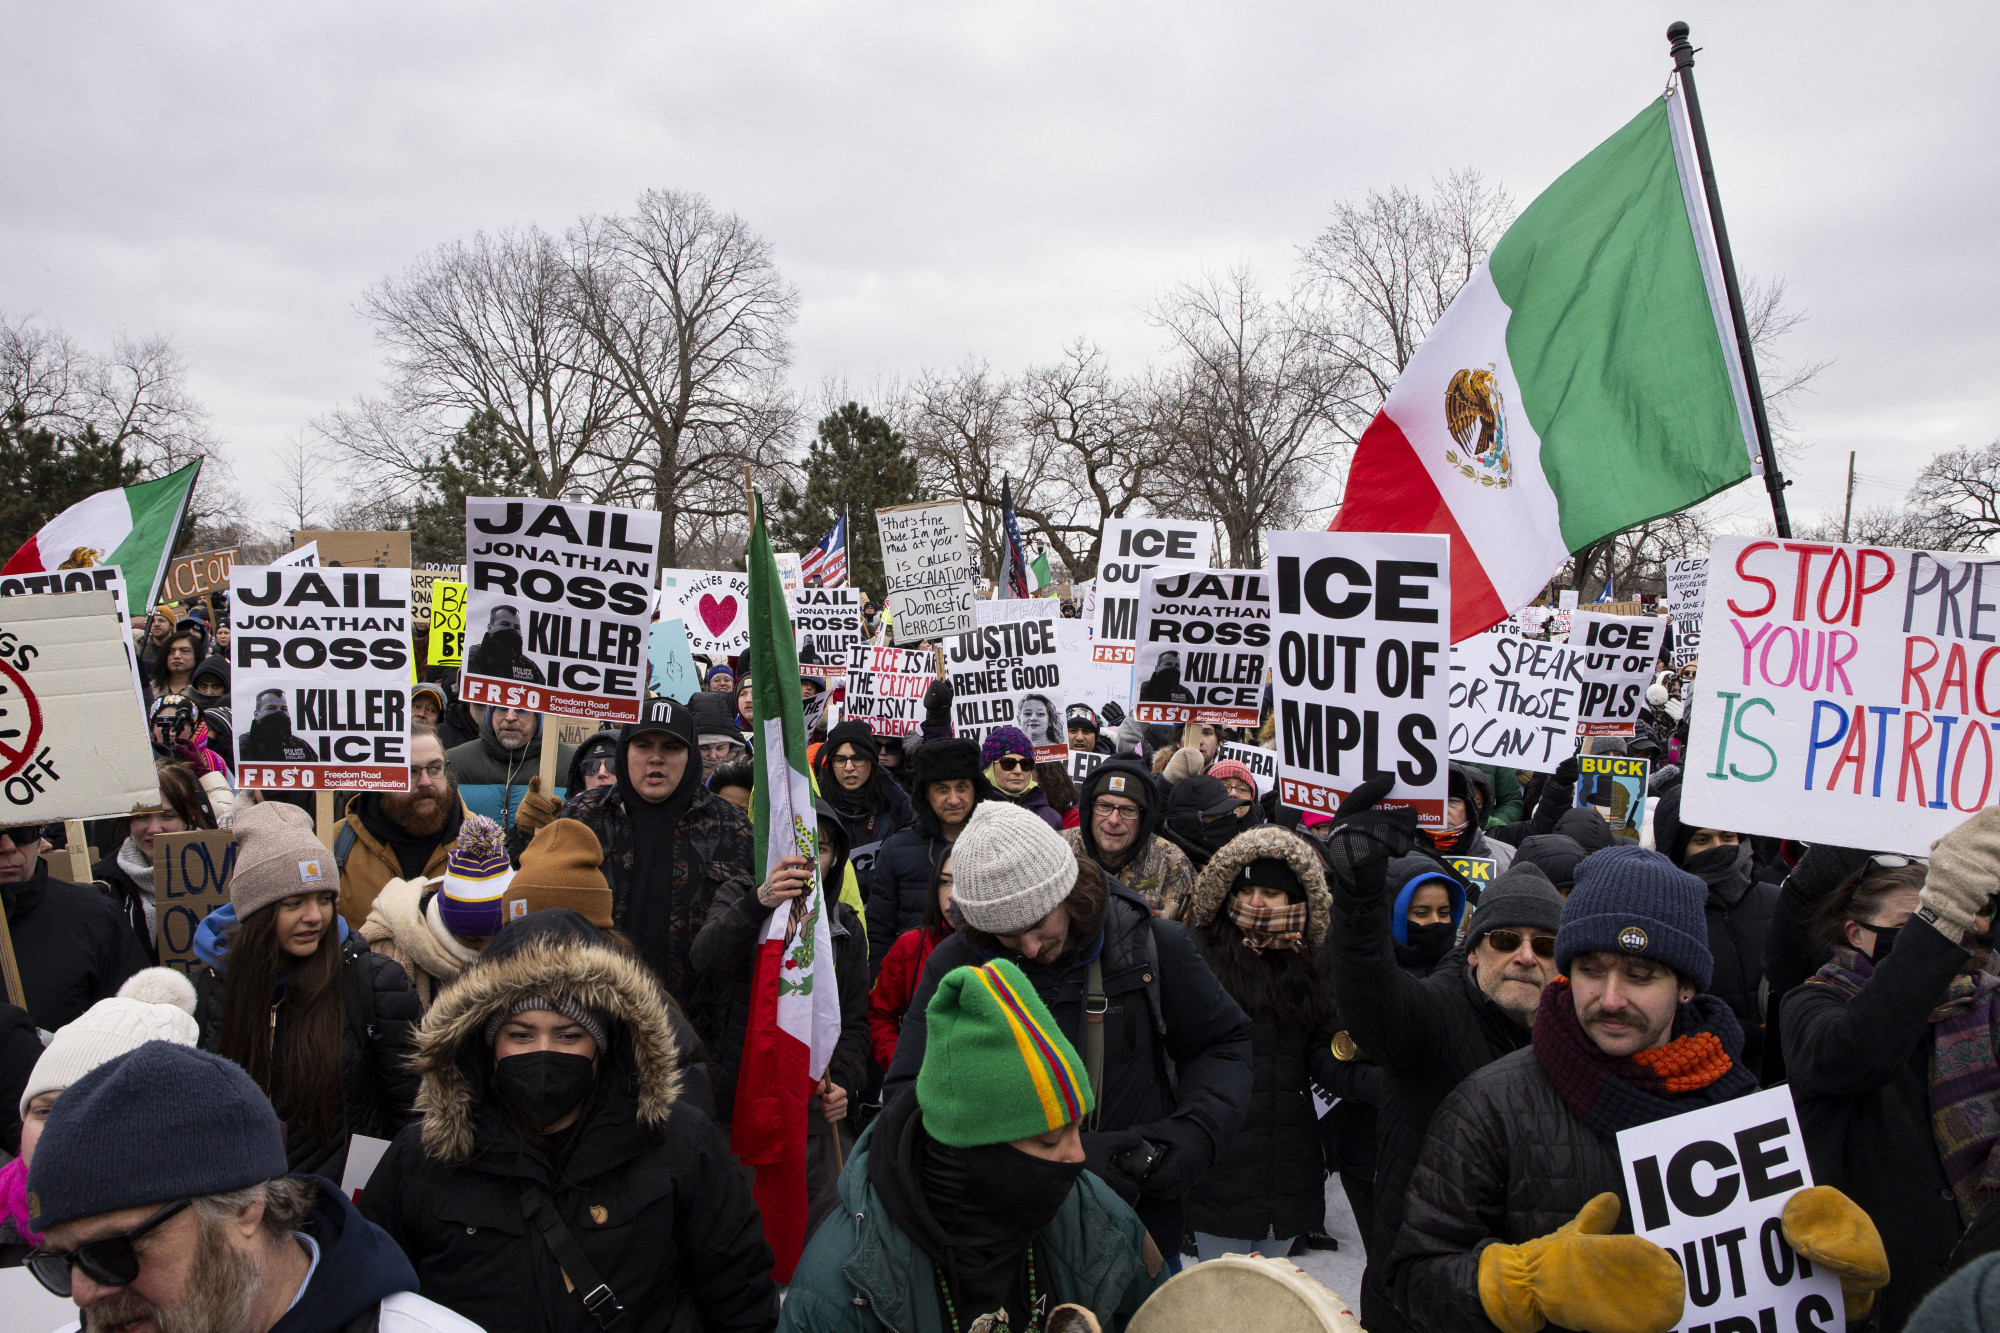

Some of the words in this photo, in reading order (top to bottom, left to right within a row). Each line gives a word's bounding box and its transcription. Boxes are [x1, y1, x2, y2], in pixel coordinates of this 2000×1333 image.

[473, 502, 653, 554] JAIL
[919, 511, 944, 527] fine
[934, 526, 950, 536] not
[1118, 528, 1197, 560] ICE
[426, 562, 440, 572] DO
[442, 564, 460, 573] NOT
[472, 542, 649, 578] JONATHAN
[918, 551, 962, 568] CALLED
[1675, 558, 1709, 573] ICE!
[164, 558, 210, 600] ICE
[1102, 562, 1160, 584] OU
[1674, 579, 1707, 591] ABSOLVE
[236, 571, 406, 609] JAIL
[442, 586, 467, 612] BA
[473, 560, 648, 616] ROSS
[730, 577, 749, 599] BEL
[796, 590, 858, 605] JAIL
[1155, 574, 1270, 602] JAIL
[1277, 556, 1439, 624] ICE
[1727, 541, 1895, 627] STOP
[1903, 551, 2000, 642] PRE
[992, 599, 1059, 623] BREAKS
[1151, 604, 1270, 619] JONATHAN
[1670, 602, 1680, 612] NO
[1683, 601, 1699, 609] ONE
[236, 615, 405, 632] JONATHAN
[434, 610, 466, 631] DO
[797, 617, 859, 630] ROSS
[1149, 619, 1270, 647] ROSS
[1679, 620, 1702, 634] KILL
[443, 631, 466, 657] BR
[527, 610, 642, 667] KILLER
[950, 619, 1056, 664] JUSTICE
[1586, 621, 1654, 651] ICE
[1676, 634, 1700, 647] IC
[237, 636, 407, 670] ROSS
[825, 654, 848, 665] IC
[849, 645, 873, 669] IF
[870, 647, 903, 673] ICE
[901, 651, 924, 673] IS
[986, 657, 1023, 669] FOR
[1279, 630, 1365, 694] OUT
[1376, 638, 1439, 700] OF
[1489, 636, 1585, 684] SPEAK
[1584, 653, 1619, 672] UT
[1620, 655, 1655, 673] OF
[1730, 619, 1859, 696] YOUR
[547, 661, 637, 697] ICE
[953, 666, 1008, 697] RENEE
[1012, 664, 1060, 690] GOOD
[1184, 652, 1265, 685] KILLER
[848, 670, 876, 695] THE
[1449, 677, 1488, 713] OR
[549, 695, 587, 708] Freedom
[587, 700, 610, 709] Road
[847, 696, 875, 717] WHY
[876, 698, 918, 719] ISN'T
[1196, 686, 1260, 707] ICE
[295, 688, 406, 732] KILLER
[549, 704, 584, 716] Socialist
[585, 708, 636, 720] Organization
[956, 698, 1014, 726] KILLED
[1221, 717, 1256, 725] Organization
[318, 735, 405, 763] ICE
[1281, 698, 1438, 787] MPLS
[1472, 718, 1567, 763] CAN'T
[1706, 691, 1777, 782] IS
[1805, 700, 2000, 812] PATRIO
[5, 746, 61, 806] OFF
[324, 770, 359, 779] Freedom
[360, 771, 381, 779] Road
[1582, 757, 1644, 776] BUCK
[324, 779, 357, 787] Socialist
[358, 779, 406, 789] Organization
[1447, 859, 1490, 880] CK
[1622, 934, 1645, 946] Gill
[1633, 1117, 1804, 1232] ICE
[1663, 1226, 1747, 1308] UT
